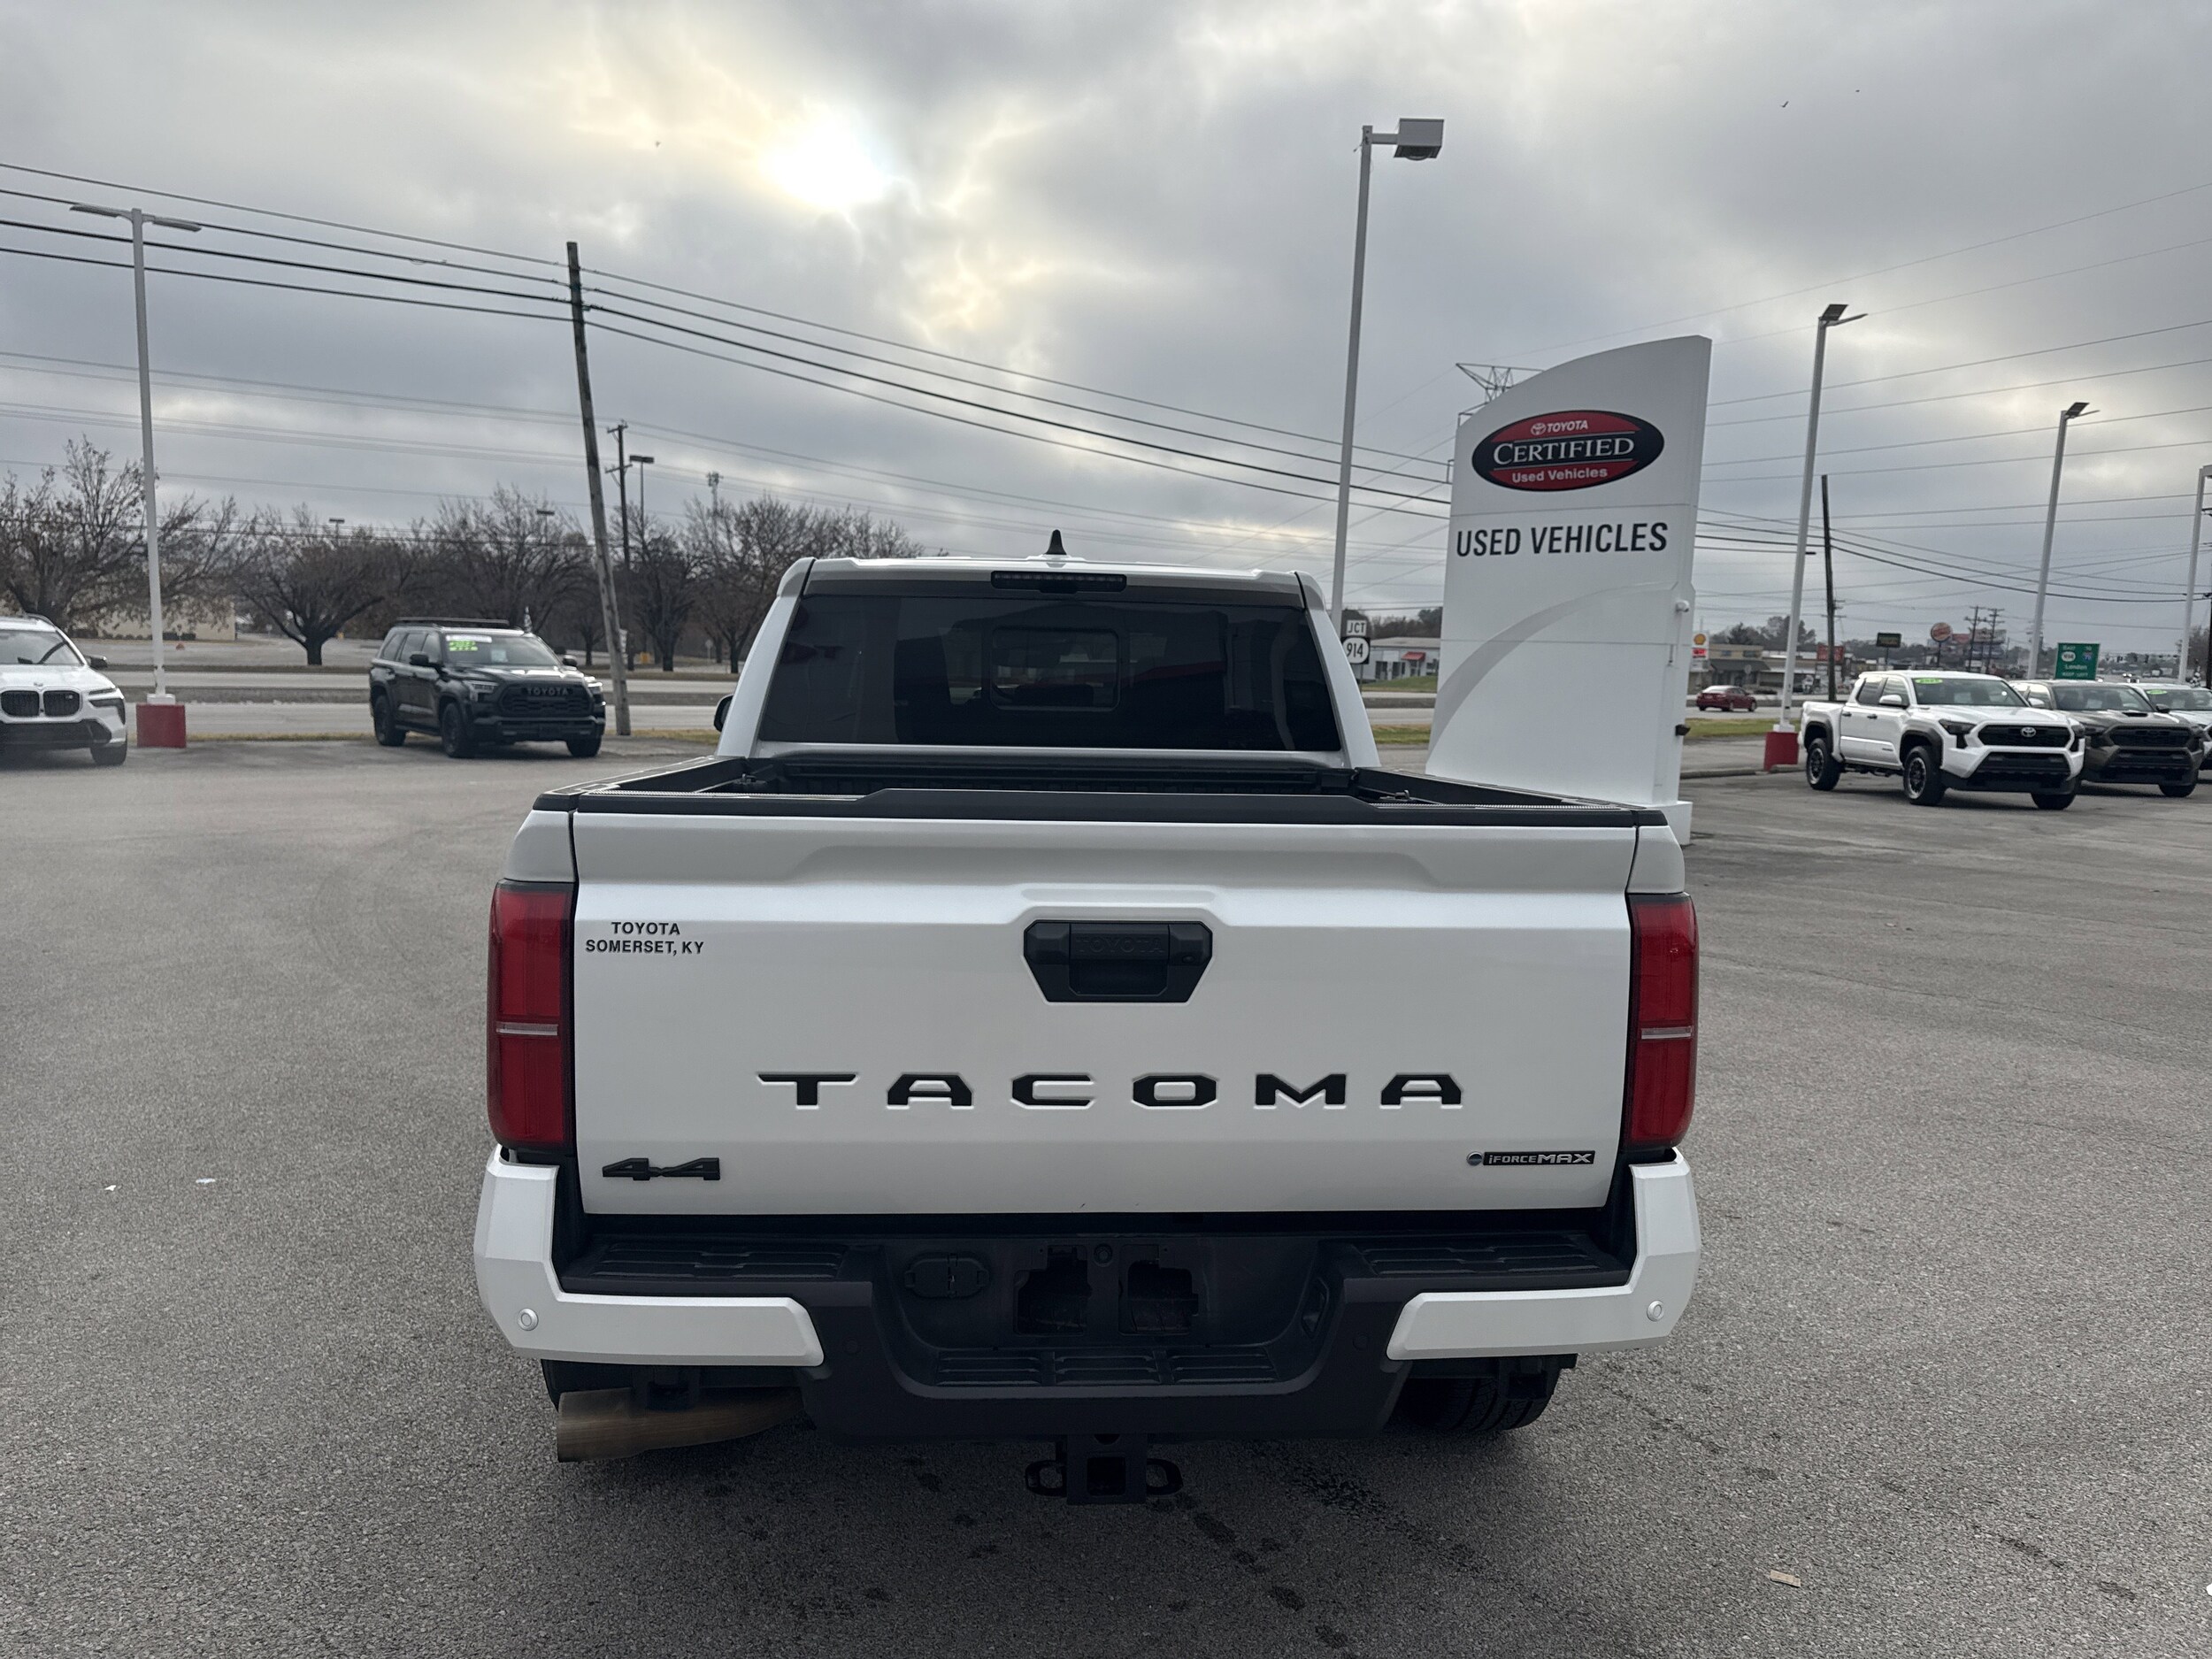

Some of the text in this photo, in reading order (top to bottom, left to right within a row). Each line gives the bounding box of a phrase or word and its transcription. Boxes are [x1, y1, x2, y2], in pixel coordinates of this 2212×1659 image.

[1547, 420, 1589, 433] TOYOTA
[1493, 437, 1635, 465] CERTIFIED
[1511, 467, 1609, 483] Used Vehicles
[1455, 522, 1669, 557] USED VEHICLES
[1348, 622, 1365, 634] JCT
[1347, 641, 1363, 658] 914
[527, 687, 569, 696] TOYOTA
[611, 921, 680, 935] TOYOTA
[585, 939, 704, 956] SOMERSET, KY
[757, 1072, 1463, 1110] TACOMA
